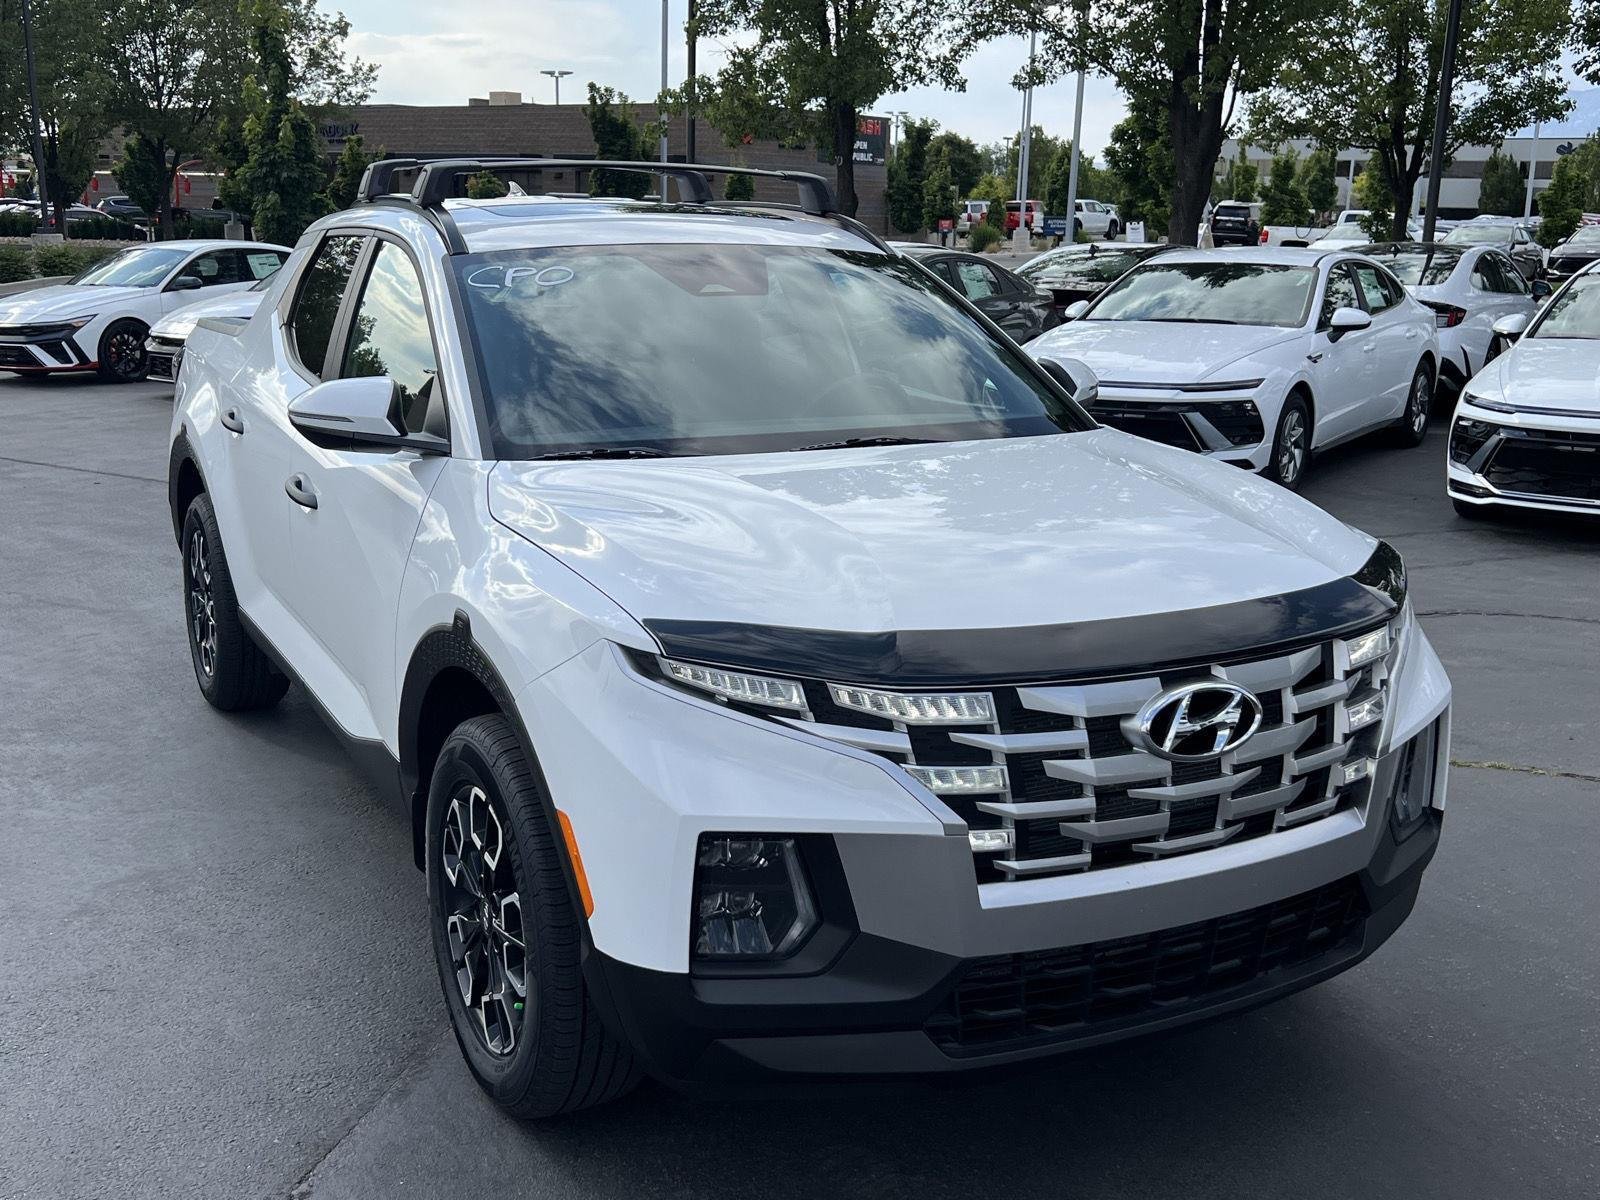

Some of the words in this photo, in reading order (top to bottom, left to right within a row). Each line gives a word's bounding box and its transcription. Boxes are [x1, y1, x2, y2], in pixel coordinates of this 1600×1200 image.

[859, 119, 881, 136] ASH
[852, 152, 873, 162] PUBLIC
[467, 265, 574, 289] CPO
